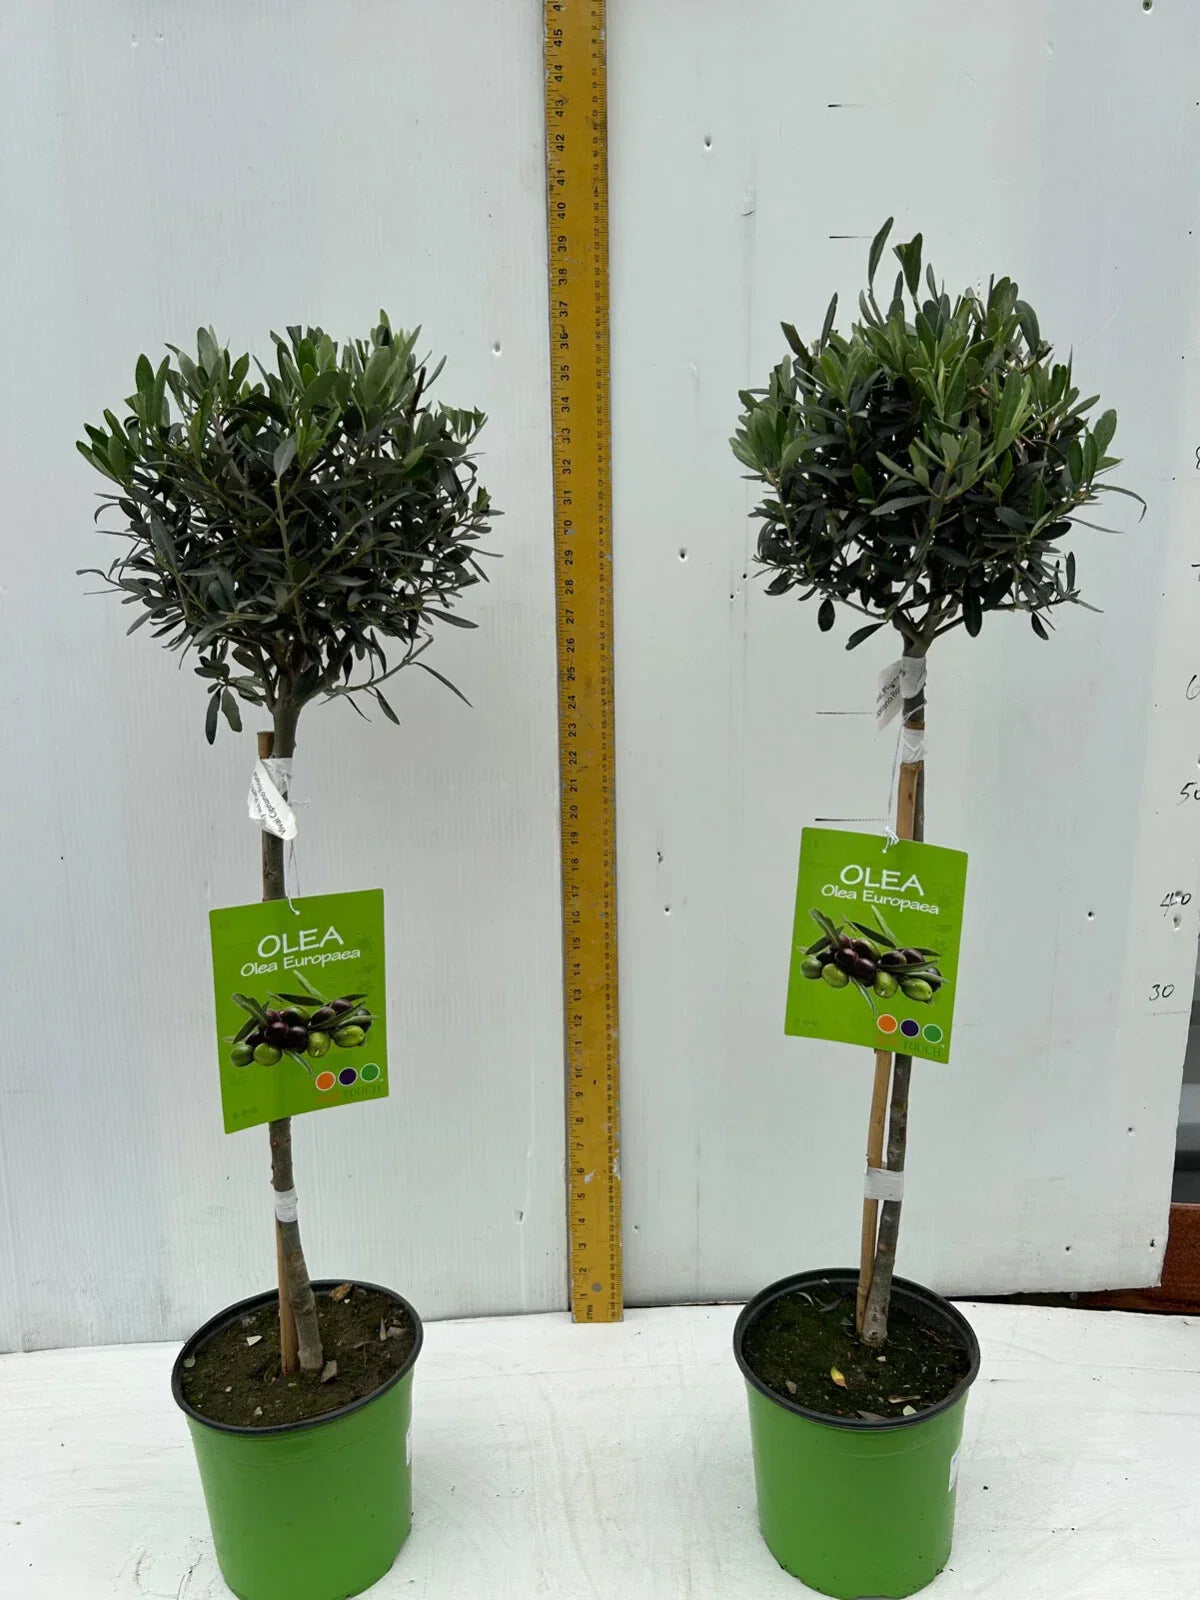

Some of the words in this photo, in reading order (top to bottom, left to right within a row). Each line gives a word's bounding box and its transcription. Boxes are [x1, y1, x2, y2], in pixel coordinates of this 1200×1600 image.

[553, 29, 563, 47] 45
[554, 64, 564, 83] 44
[554, 99, 564, 118] 43
[555, 134, 565, 152] 42
[556, 169, 566, 186] 41
[556, 202, 567, 220] 40
[557, 235, 567, 252] 39
[558, 268, 568, 285] 38
[559, 301, 569, 317] 37
[559, 333, 569, 350] 36
[560, 364, 570, 381] 35
[560, 396, 570, 413] 34
[561, 427, 571, 444] 33
[561, 459, 571, 475] 32
[563, 490, 572, 505] 31
[564, 550, 574, 565] 29
[564, 579, 574, 595] 28
[565, 609, 575, 624] 27
[566, 638, 575, 653] 26
[566, 666, 576, 681] 25
[567, 695, 577, 709] 24
[567, 723, 577, 737] 23
[568, 751, 577, 765] 22
[568, 778, 578, 793] 21
[570, 805, 579, 820] 20
[570, 831, 579, 845] 19
[570, 858, 580, 871] 18
[840, 864, 925, 896] OLEA
[571, 885, 580, 898] 17
[821, 884, 857, 900] Olea
[862, 889, 939, 915] Europaea
[257, 926, 344, 958] OLEA
[572, 937, 581, 950] 15
[240, 962, 278, 977] Olea
[283, 949, 361, 968] Europaea
[572, 963, 581, 976] 14
[573, 988, 582, 1002] 13
[1149, 984, 1175, 1001] 30
[573, 1014, 582, 1027] 12
[573, 1040, 582, 1056] 1
